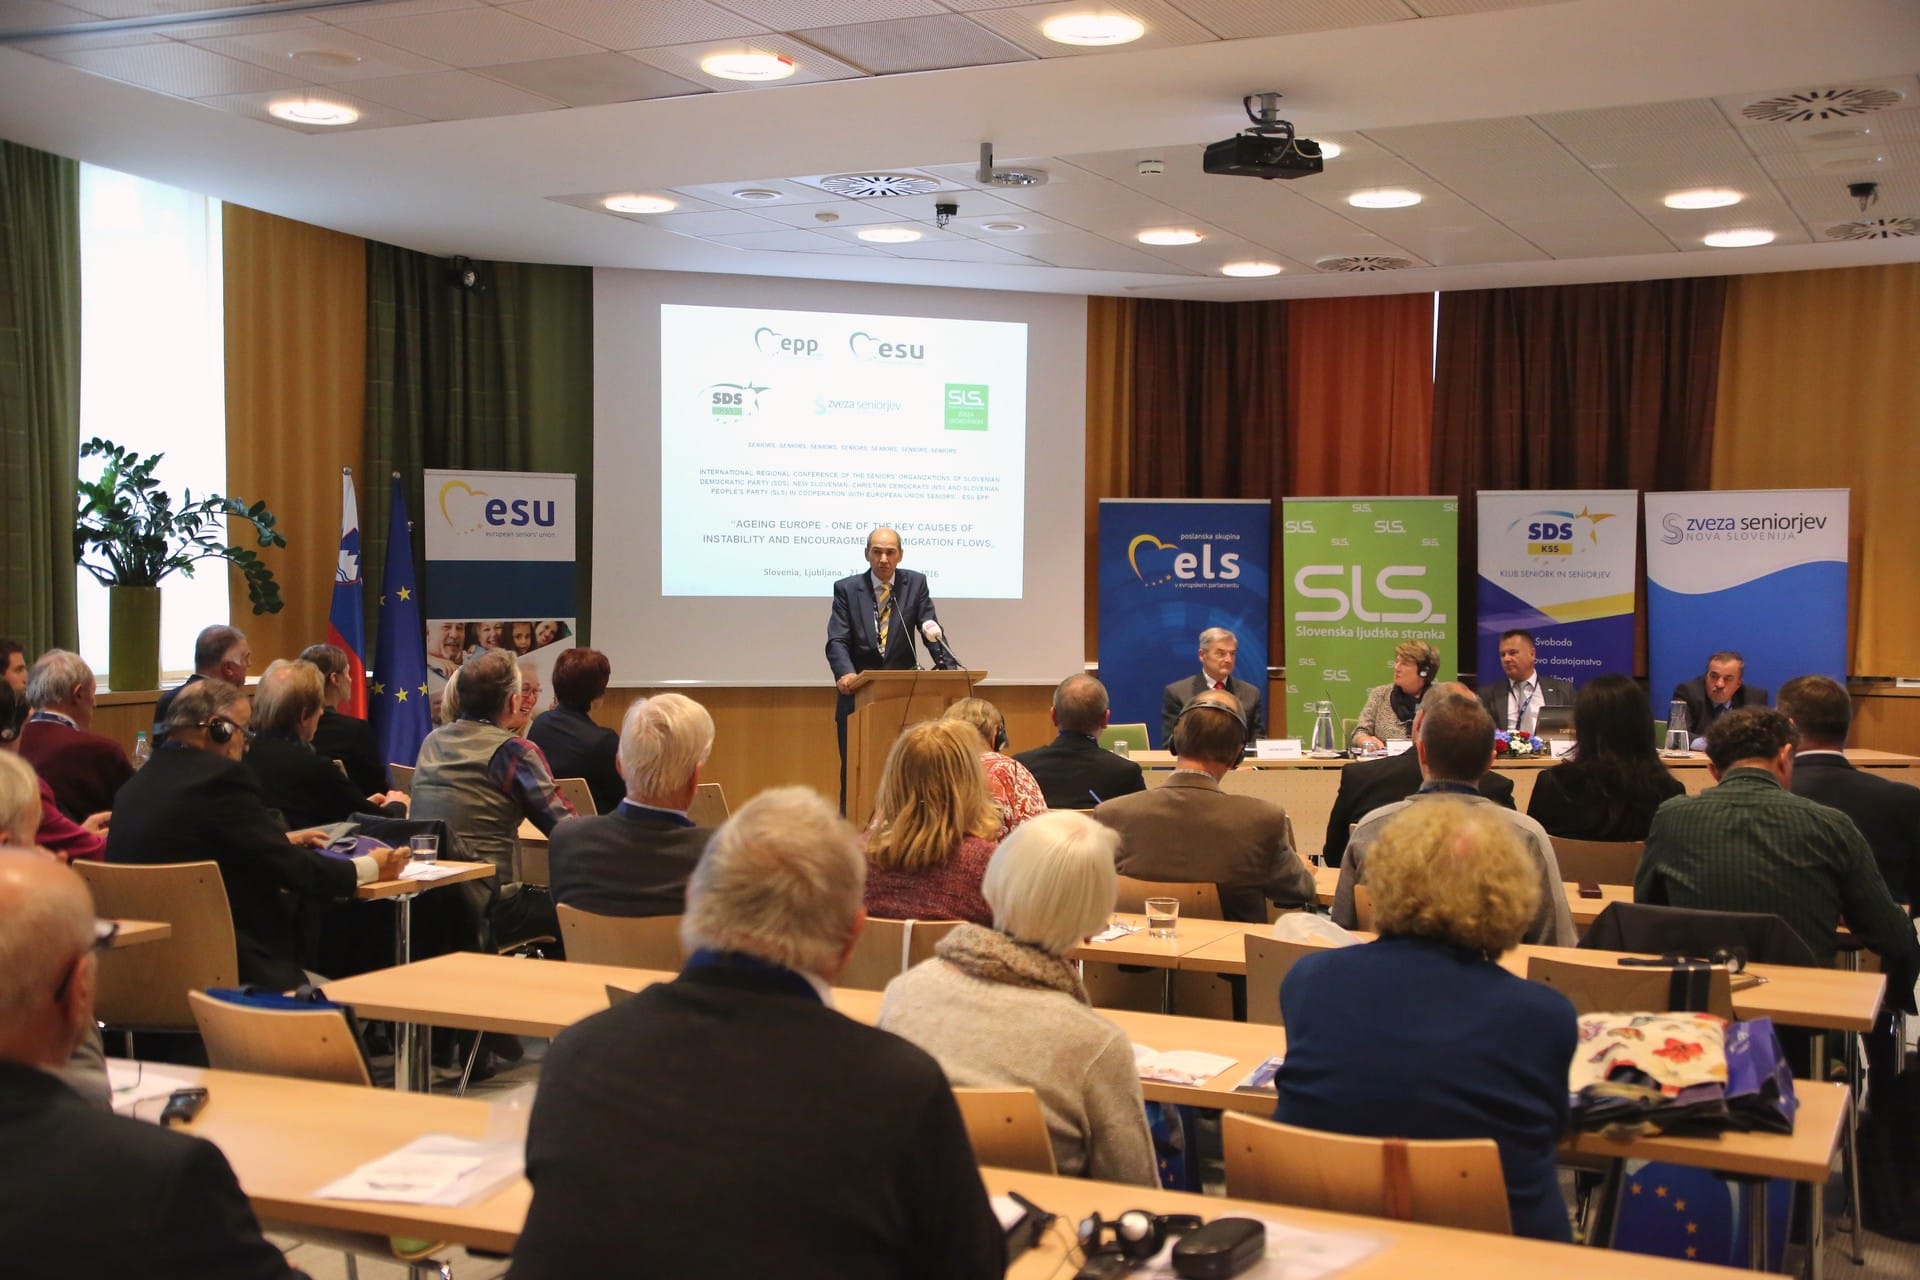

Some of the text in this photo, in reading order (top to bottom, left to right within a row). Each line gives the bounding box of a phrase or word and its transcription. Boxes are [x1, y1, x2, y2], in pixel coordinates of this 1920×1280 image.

[780, 337, 819, 356] epp
[878, 342, 925, 360] esu
[712, 392, 743, 406] SDS
[828, 400, 902, 411] zveza seniorjev
[485, 498, 555, 527] esu
[780, 520, 821, 529] EUROPE
[831, 521, 853, 530] ONE
[856, 522, 869, 530] OF
[895, 522, 915, 531] KEY
[917, 523, 958, 532] CAUSES
[960, 524, 974, 532] OF
[1686, 512, 1828, 534] zveza seniorjev
[1180, 533, 1240, 541] poslanska skupina
[1528, 523, 1573, 540] SDS
[1686, 531, 1796, 541] NOVA SLOVENIJA
[703, 534, 765, 544] INSTABILITY
[768, 535, 790, 544] AND
[1541, 545, 1560, 553] KSS
[1174, 543, 1241, 580] els
[763, 568, 802, 577] Slovenia,
[804, 568, 845, 578] Ljubljana,
[1568, 571, 1611, 579] SENIORJEV
[1295, 625, 1445, 640] Slovenska ljudska stranka
[1535, 637, 1573, 647] Svoboda
[1550, 656, 1602, 668] dostojanstvo
